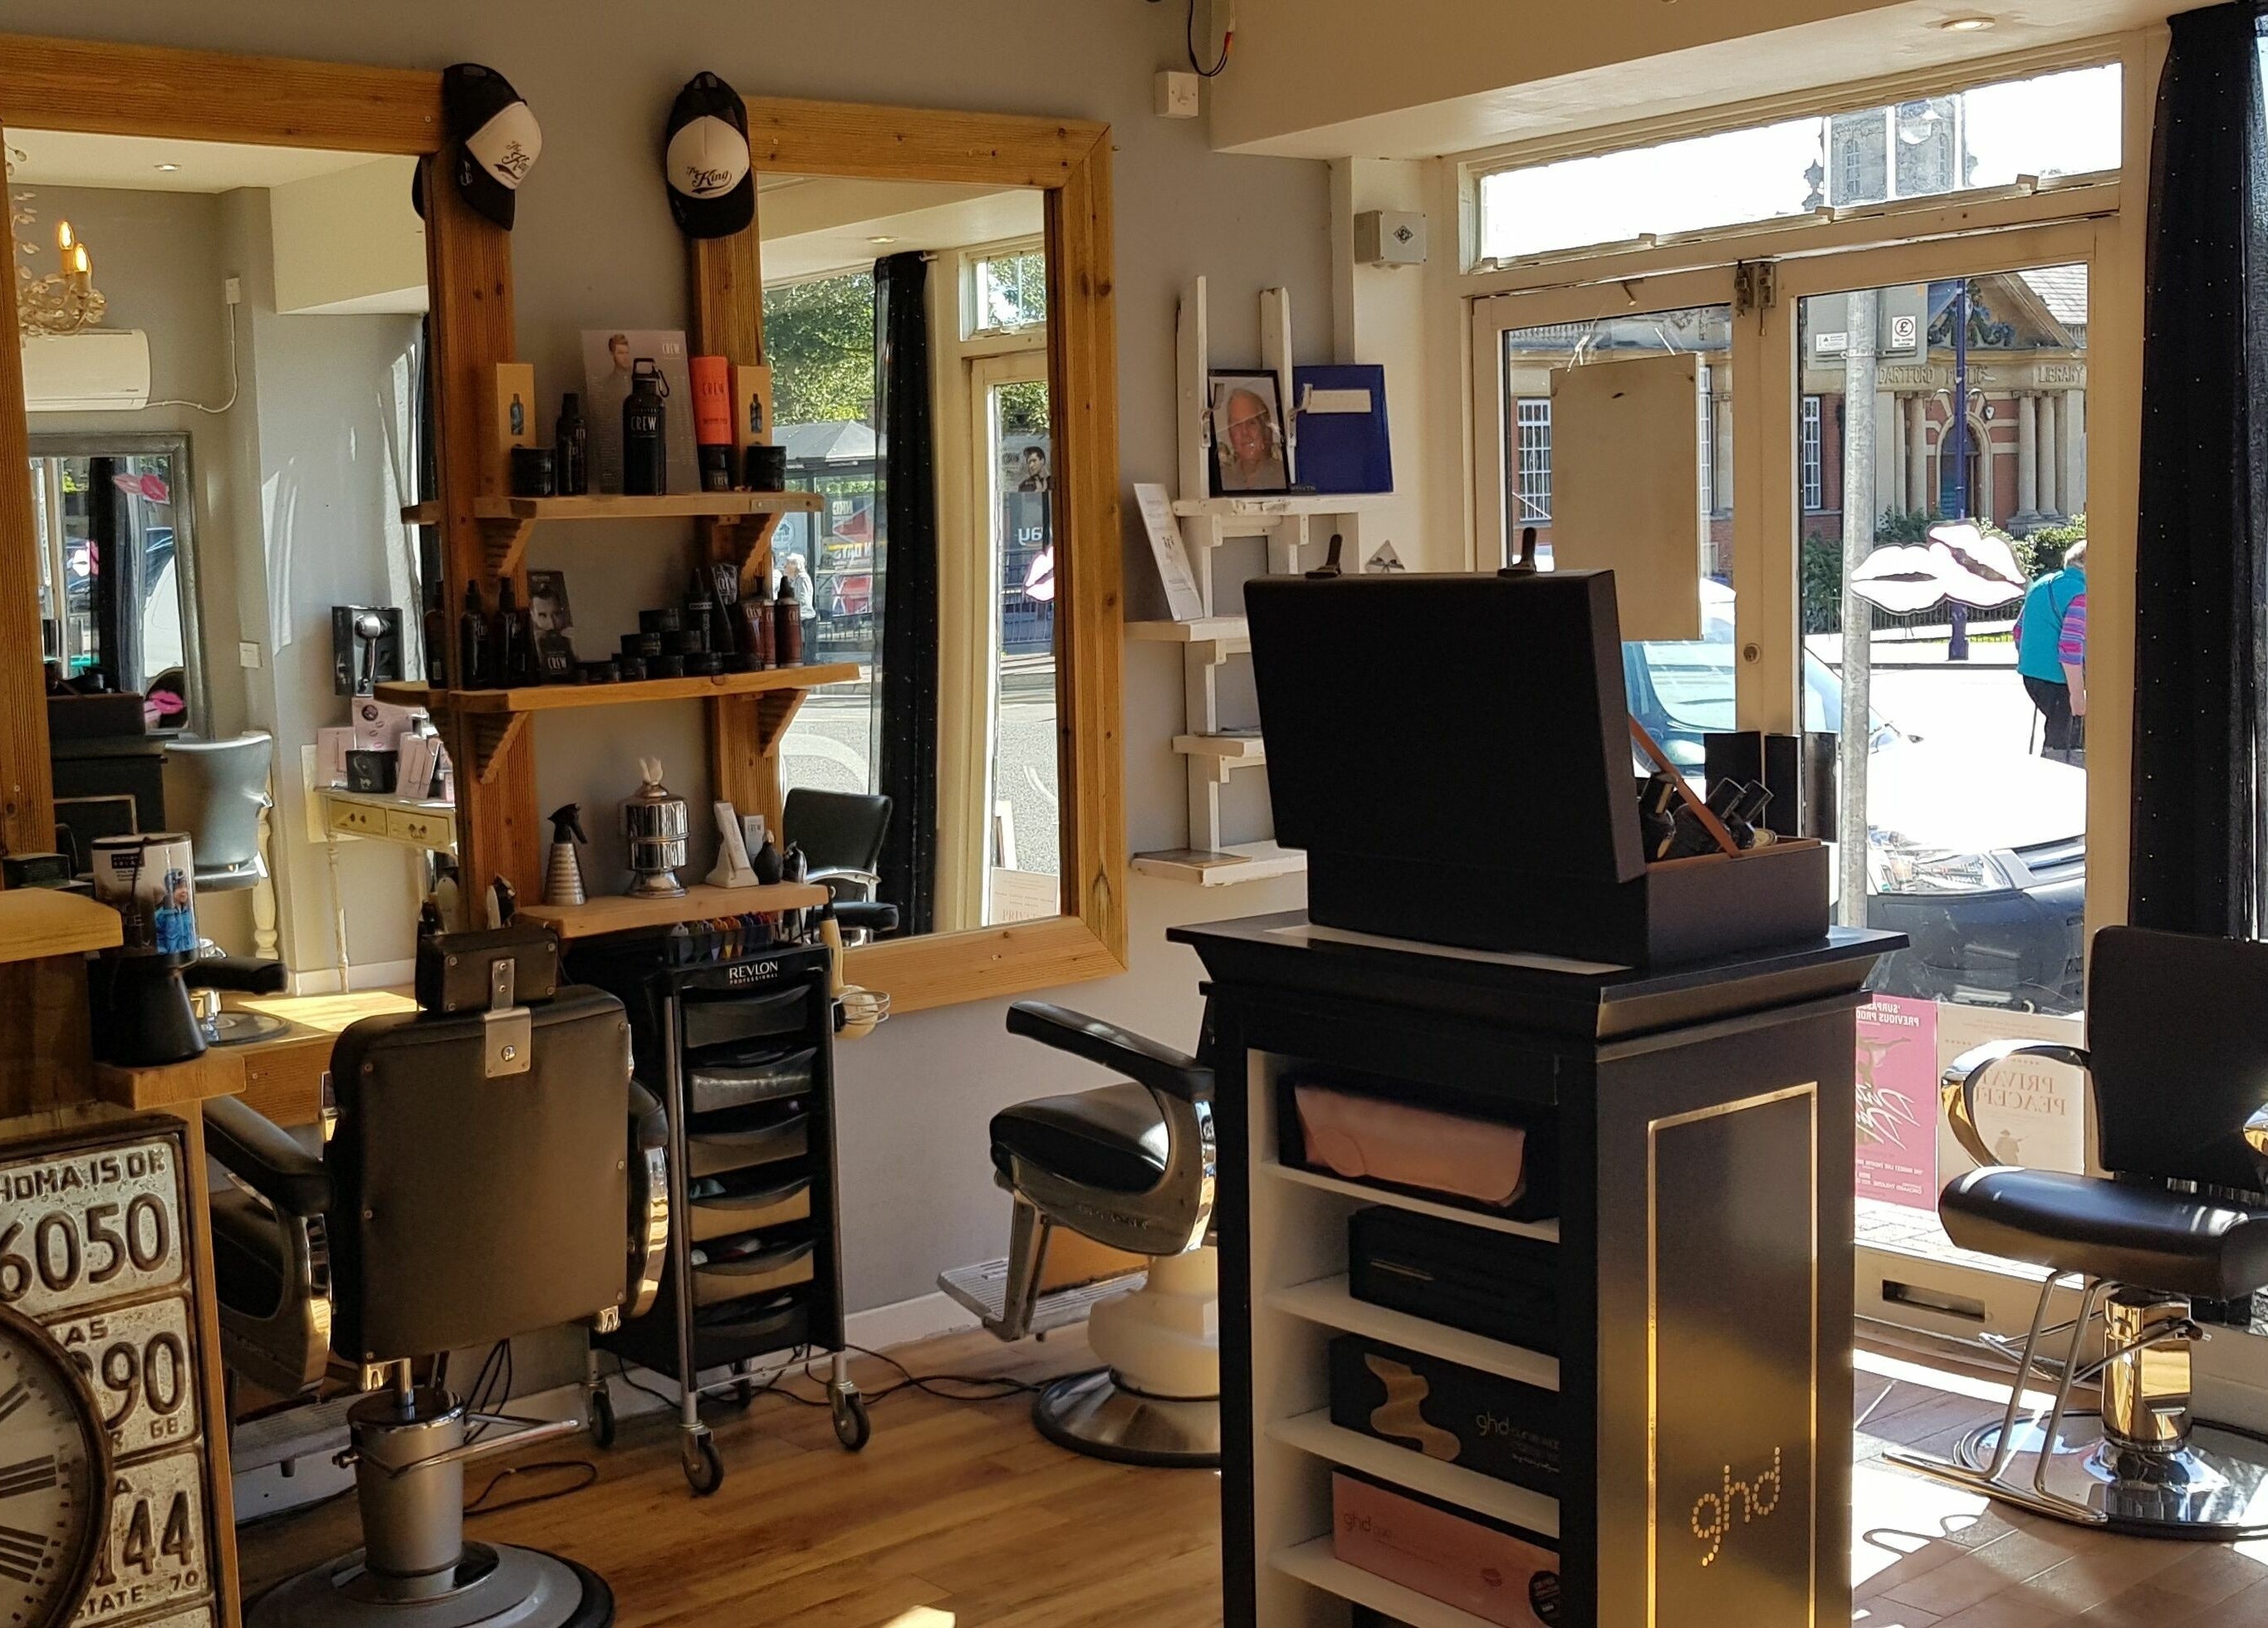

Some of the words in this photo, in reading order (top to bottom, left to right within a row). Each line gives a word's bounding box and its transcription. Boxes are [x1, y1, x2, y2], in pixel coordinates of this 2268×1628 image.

[691, 169, 732, 188] King
[1877, 365, 1934, 385] DARTFORD
[1946, 365, 1986, 385] PLIC
[2037, 365, 2084, 384] LIBRARY
[630, 415, 658, 433] CREW
[728, 960, 779, 980] REVLON
[728, 973, 779, 986] PROFESSIONAL
[91, 1155, 121, 1186] IS
[0, 1193, 169, 1302] 6050
[1475, 1410, 1511, 1437] ghd
[1691, 1446, 1781, 1567] ghd
[1343, 1511, 1372, 1532] ghd
[169, 1569, 199, 1591] 70
